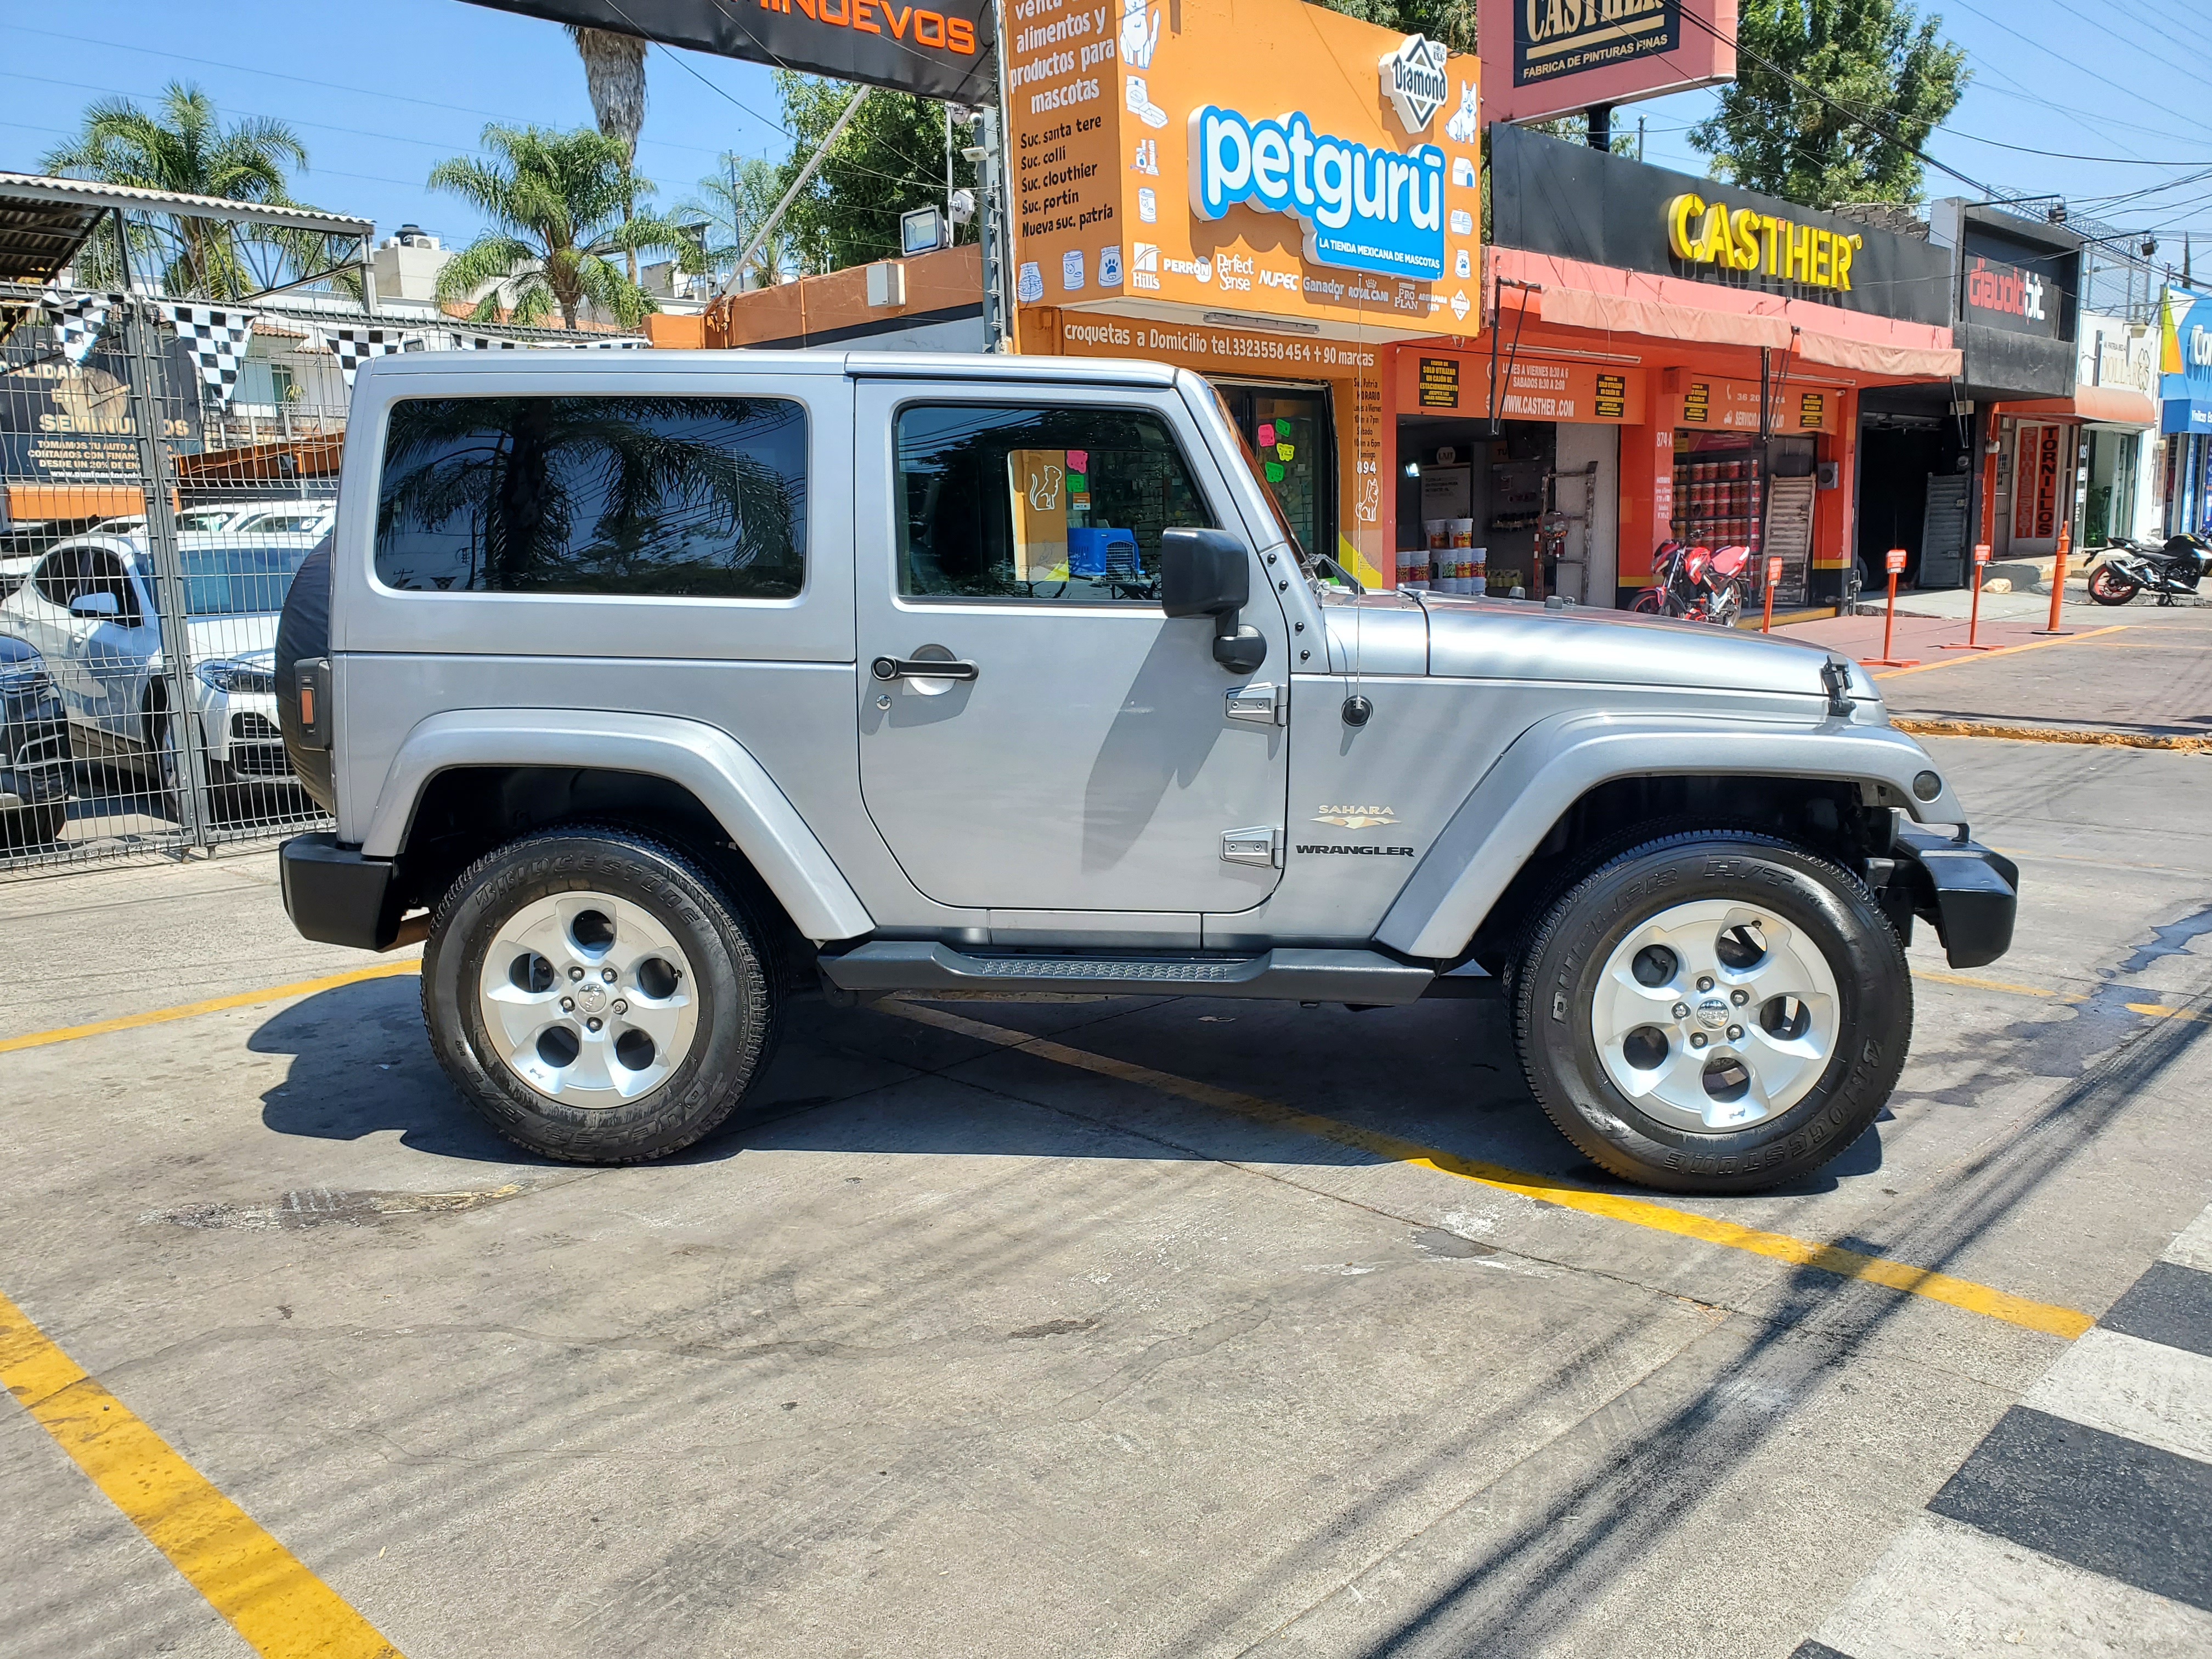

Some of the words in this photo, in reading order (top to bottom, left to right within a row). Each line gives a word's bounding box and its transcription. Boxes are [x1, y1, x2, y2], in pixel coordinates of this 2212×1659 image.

[1017, 13, 1091, 53] alimentos
[1094, 6, 1105, 34] y
[1010, 50, 1075, 94] productos
[1081, 38, 1115, 72] para
[1523, 59, 1566, 78] FABRICA
[1567, 55, 1582, 68] DE
[1583, 42, 1634, 65] PINTURAS
[1636, 34, 1668, 52] FINAS
[1392, 54, 1446, 102] Diamond
[1031, 78, 1099, 114] mascotas
[1020, 133, 1041, 149] Suc.
[1043, 123, 1071, 144] santa
[1076, 116, 1102, 133] tere
[1020, 156, 1041, 171] Suc.
[1043, 145, 1066, 164] colli
[1022, 177, 1041, 193] Suc.
[1043, 162, 1098, 188] clouthier
[1022, 199, 1042, 215] Suc.
[1022, 220, 1054, 238] Nueva
[1056, 216, 1076, 230] suc.
[1668, 192, 1853, 291] CASTHER
[1216, 253, 1254, 274] Perfect
[1319, 237, 1330, 249] LA
[1330, 239, 1357, 254] TIENDA
[1357, 245, 1393, 261] MEXICANA
[1394, 251, 1404, 262] DE
[1404, 253, 1440, 269] MASCOTAS
[1132, 272, 1160, 290] Hill's
[1220, 271, 1251, 291] Sense
[1258, 269, 1299, 291] NUPEC
[1302, 276, 1344, 297] Ganador
[1348, 286, 1370, 300] ROYAL
[1394, 296, 1418, 310] PLAN
[1398, 287, 1415, 300] PRO
[1064, 323, 1130, 346] croquetas
[1137, 331, 1145, 347] a
[1150, 329, 1207, 353] Domicilio
[1324, 347, 1336, 364] 90
[1339, 351, 1374, 367] marcas
[1435, 367, 1456, 376] UTILIZAR
[1521, 364, 1526, 375] A
[1527, 365, 1548, 377] VIERNES
[1560, 368, 1564, 377] A
[1565, 368, 1568, 379] 6
[1513, 377, 1538, 388] SABADOS
[1550, 380, 1554, 390] A
[1357, 391, 1380, 400] HORARIO
[1737, 393, 1747, 401] 36
[1357, 460, 1376, 475] 894
[2038, 426, 2059, 536] TORNILLOS
[1318, 805, 1395, 815] SAHARA
[1296, 845, 1415, 857] WRANGLER
